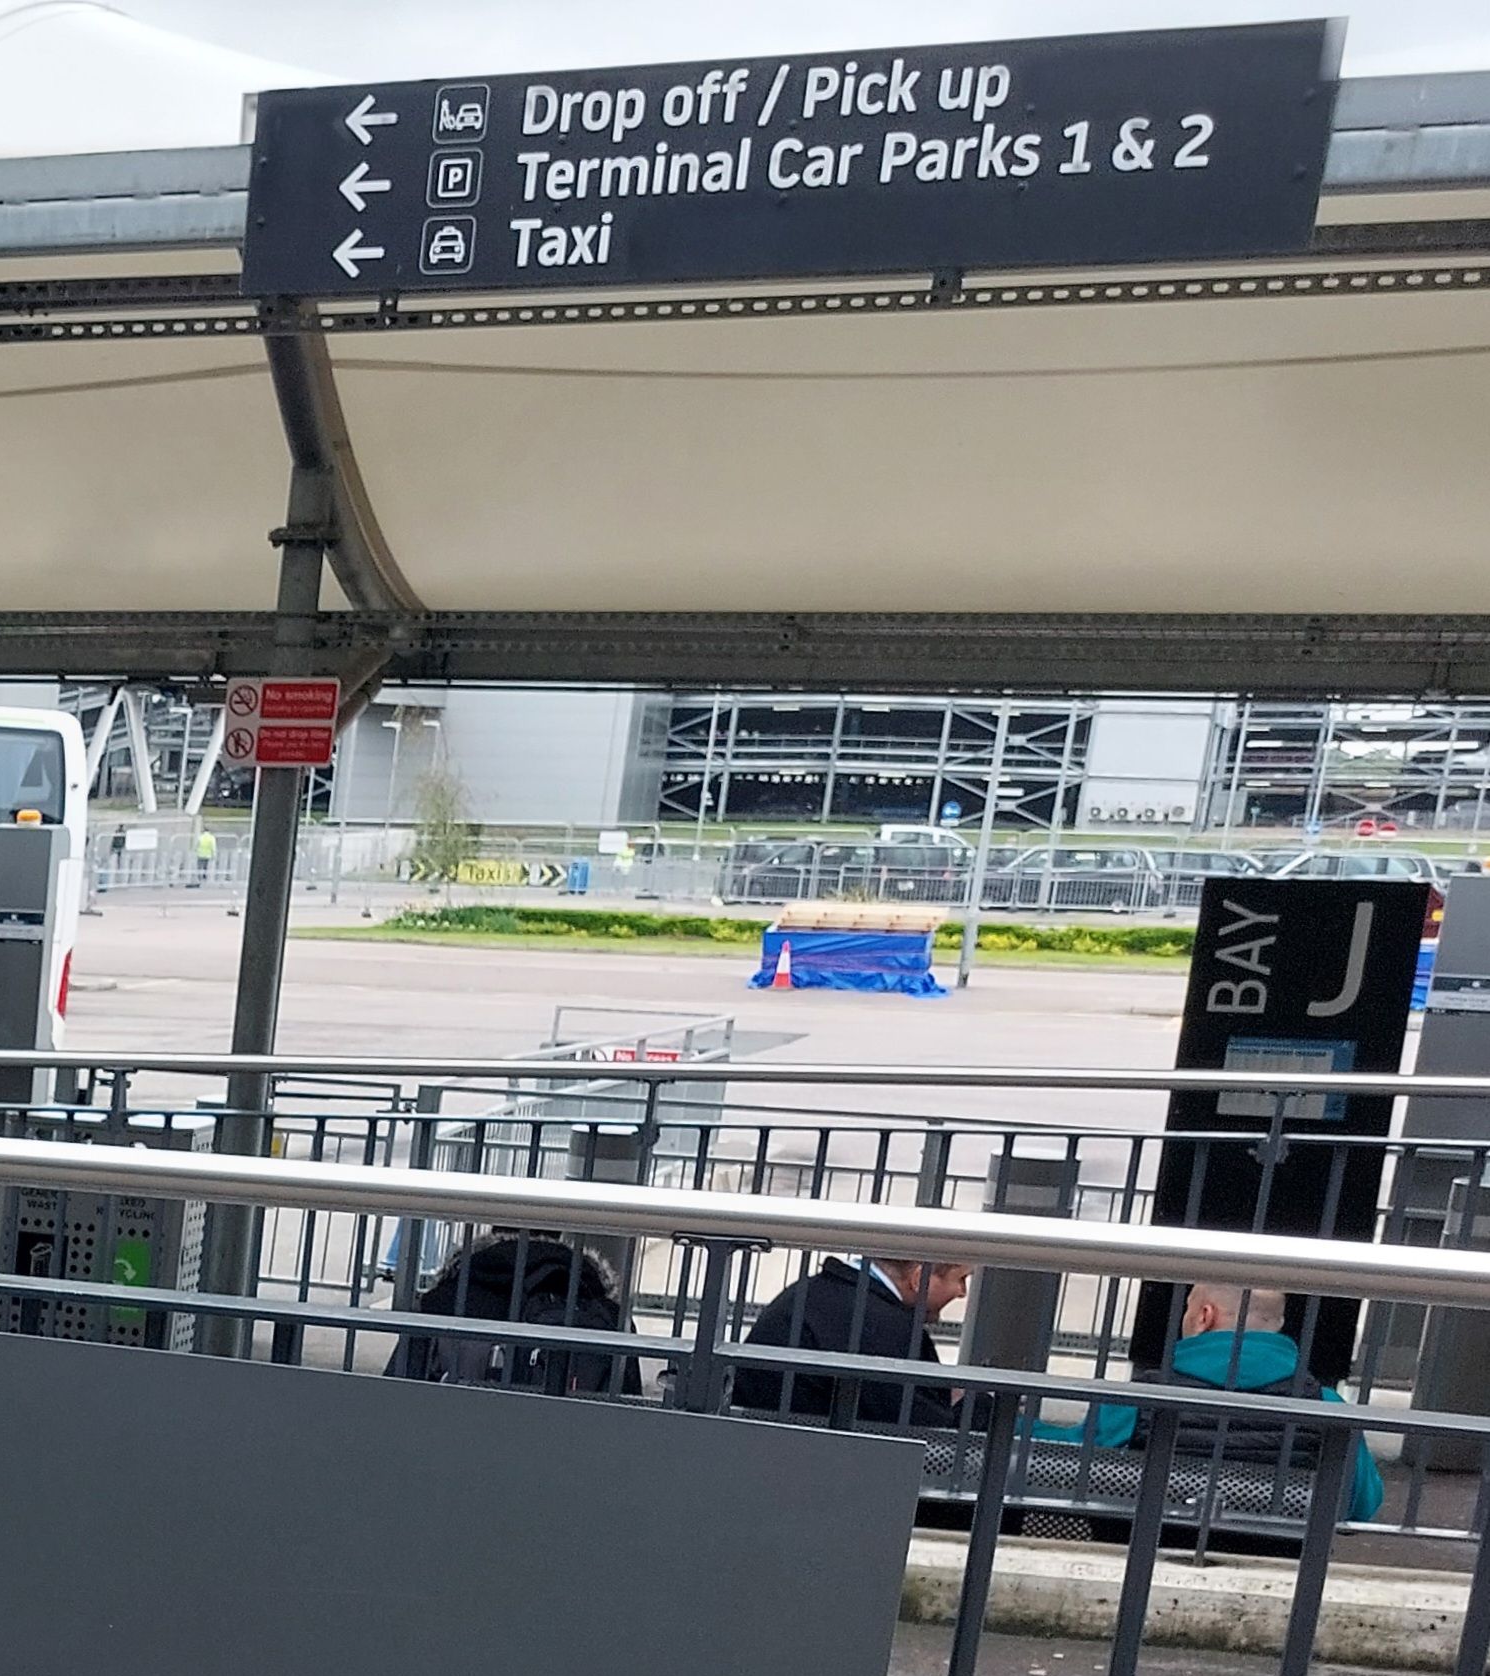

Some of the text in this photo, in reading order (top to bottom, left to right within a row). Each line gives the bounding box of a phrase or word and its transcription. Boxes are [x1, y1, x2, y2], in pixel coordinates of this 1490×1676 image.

[522, 59, 1010, 143] Drop off / Pick up
[518, 114, 1214, 201] Terminal Car Parks 1 & 2
[511, 211, 612, 267] Taxi
[265, 688, 333, 703] No smoking
[1206, 899, 1373, 1017] BAY J
